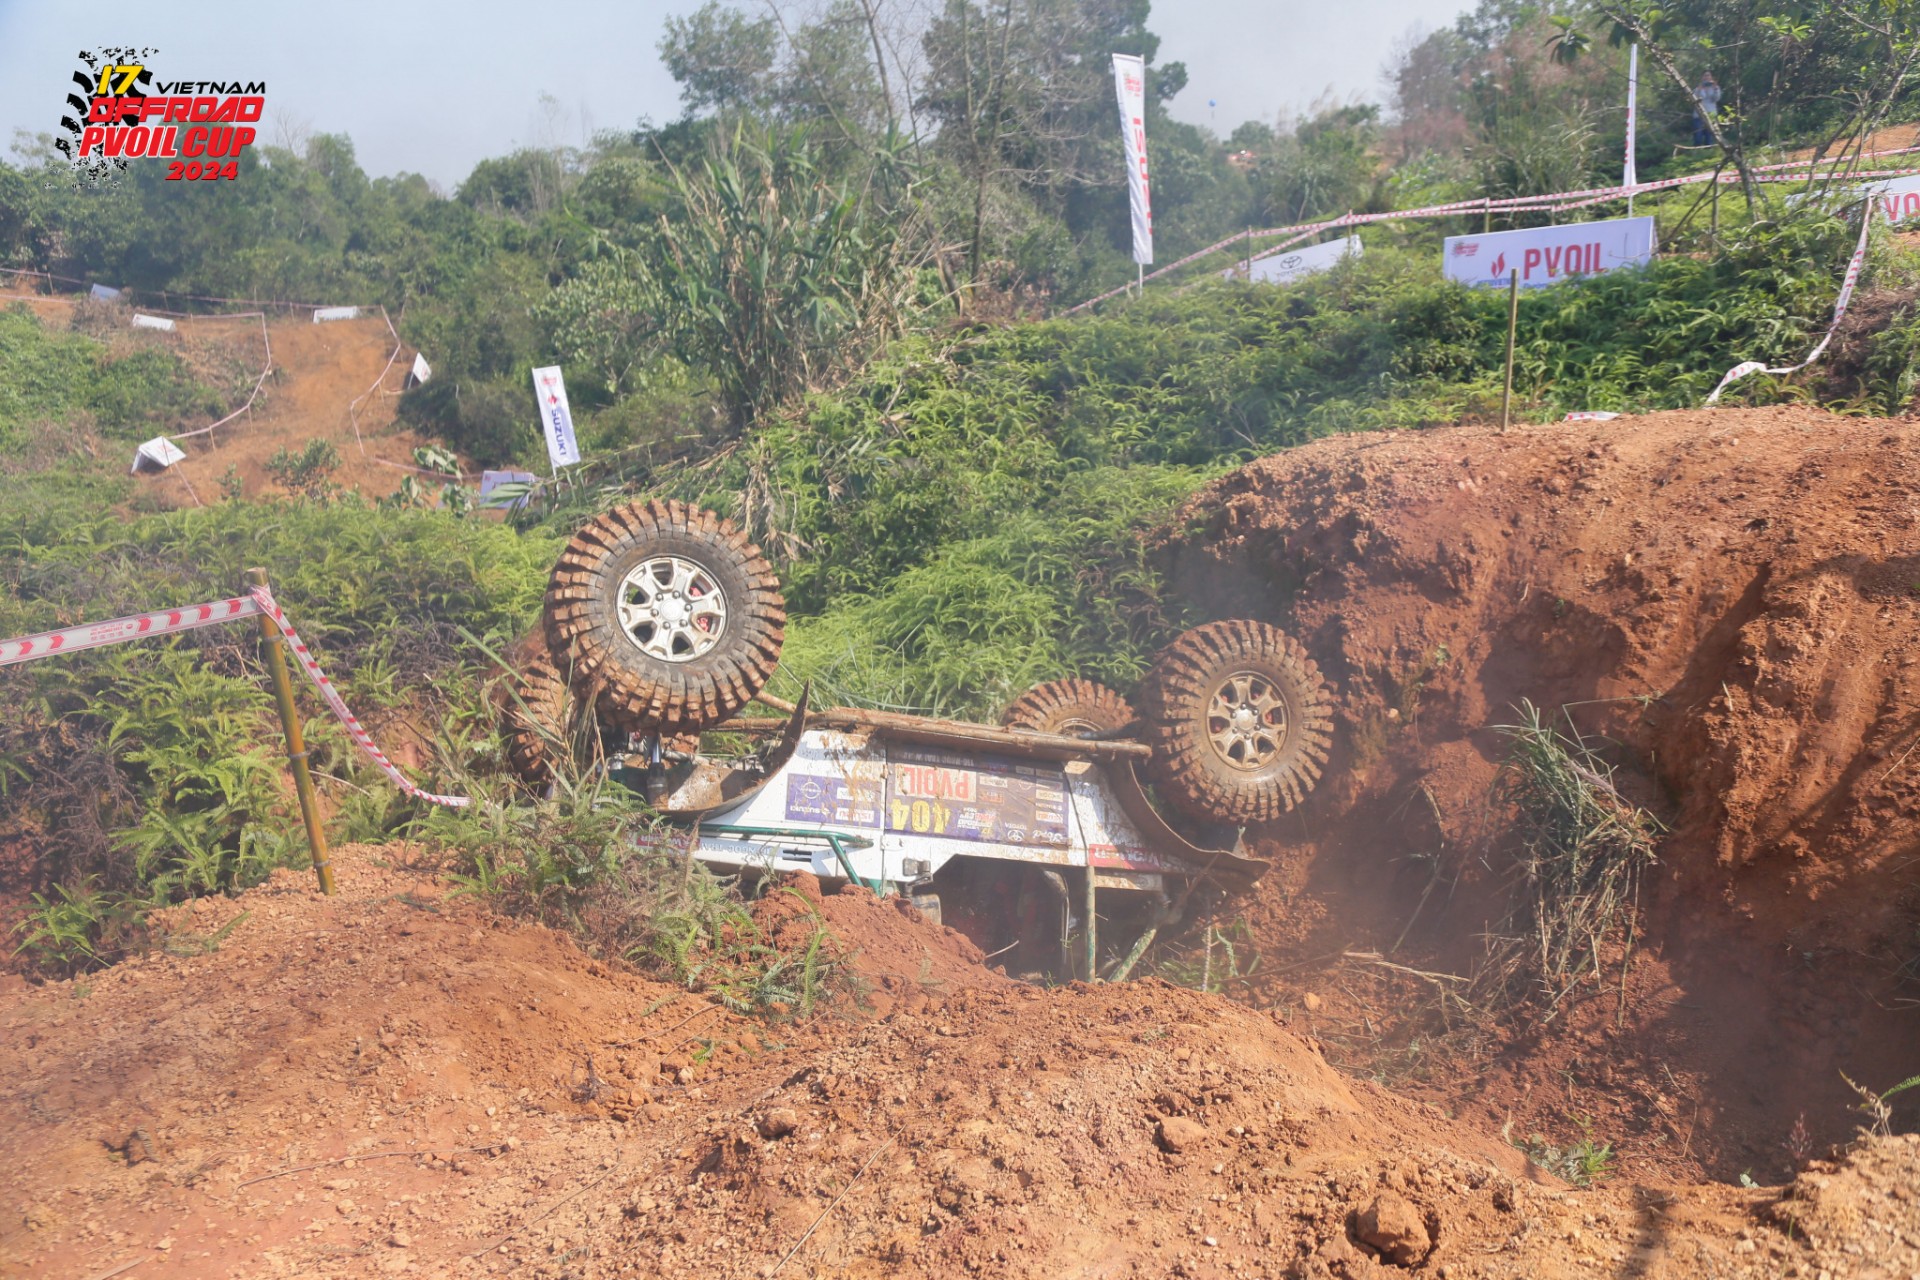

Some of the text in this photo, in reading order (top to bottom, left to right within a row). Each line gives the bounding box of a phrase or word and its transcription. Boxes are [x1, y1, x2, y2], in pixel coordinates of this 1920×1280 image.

[1878, 192, 1920, 221] VO
[1523, 242, 1607, 280] PVOIL
[551, 409, 567, 456] SUZUKI
[906, 767, 969, 798] PVOIL
[890, 798, 951, 834] 404
[1004, 821, 1027, 830] TOYOTA
[1032, 829, 1064, 843] Ford
